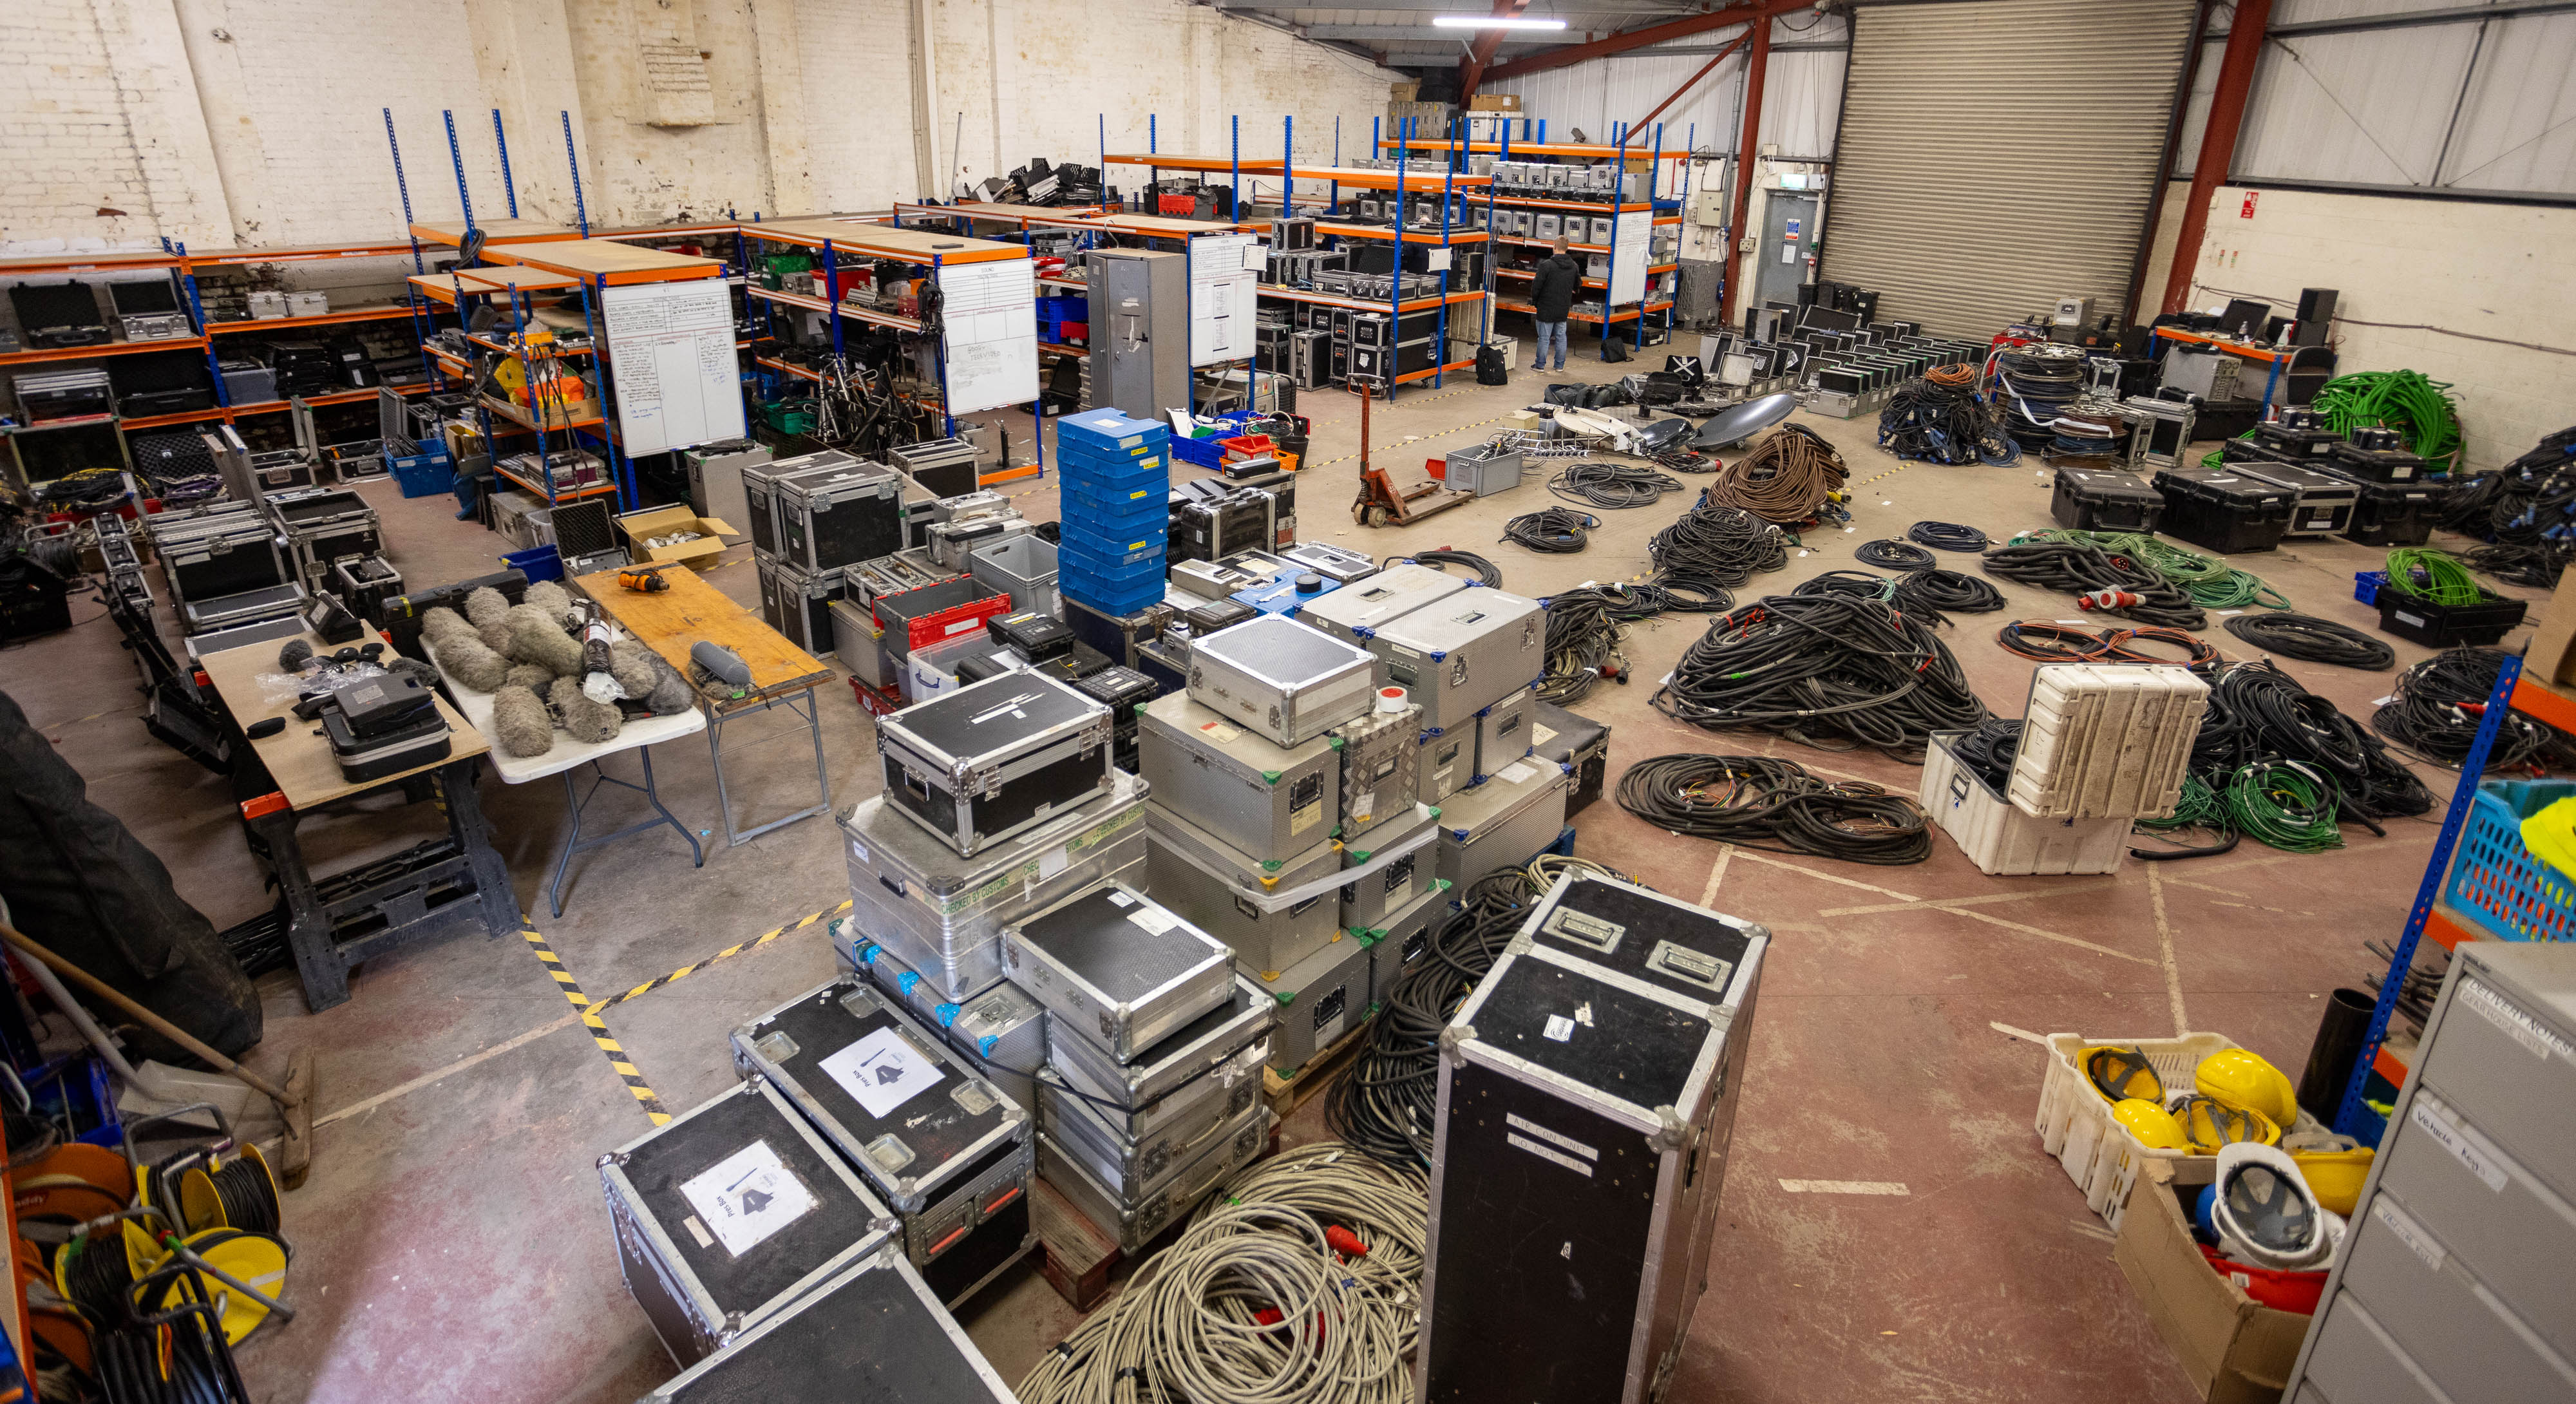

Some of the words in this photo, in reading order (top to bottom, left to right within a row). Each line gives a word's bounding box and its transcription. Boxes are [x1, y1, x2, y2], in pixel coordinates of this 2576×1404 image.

[1132, 447, 1148, 455] MCARM
[1097, 818, 1119, 835] CHECKED
[1120, 813, 1128, 823] BY
[941, 895, 971, 915] CHECKED
[972, 890, 981, 902] BY
[981, 876, 1010, 898] CUSTOMS
[1023, 860, 1040, 876] CHEC
[2469, 979, 2525, 1021] DELIVERY
[2526, 1018, 2571, 1054] NOTES
[853, 1069, 862, 1080] Box
[860, 1076, 871, 1088] Pres
[1513, 1117, 1531, 1130] AIR
[1536, 1128, 1557, 1142] CON
[1564, 1139, 1589, 1155] UNIT
[2417, 1110, 2452, 1146] Vehicle
[1513, 1136, 1528, 1148] DO
[1534, 1145, 1557, 1160] NOT
[716, 1195, 726, 1207] Box
[724, 1206, 734, 1218] Pres
